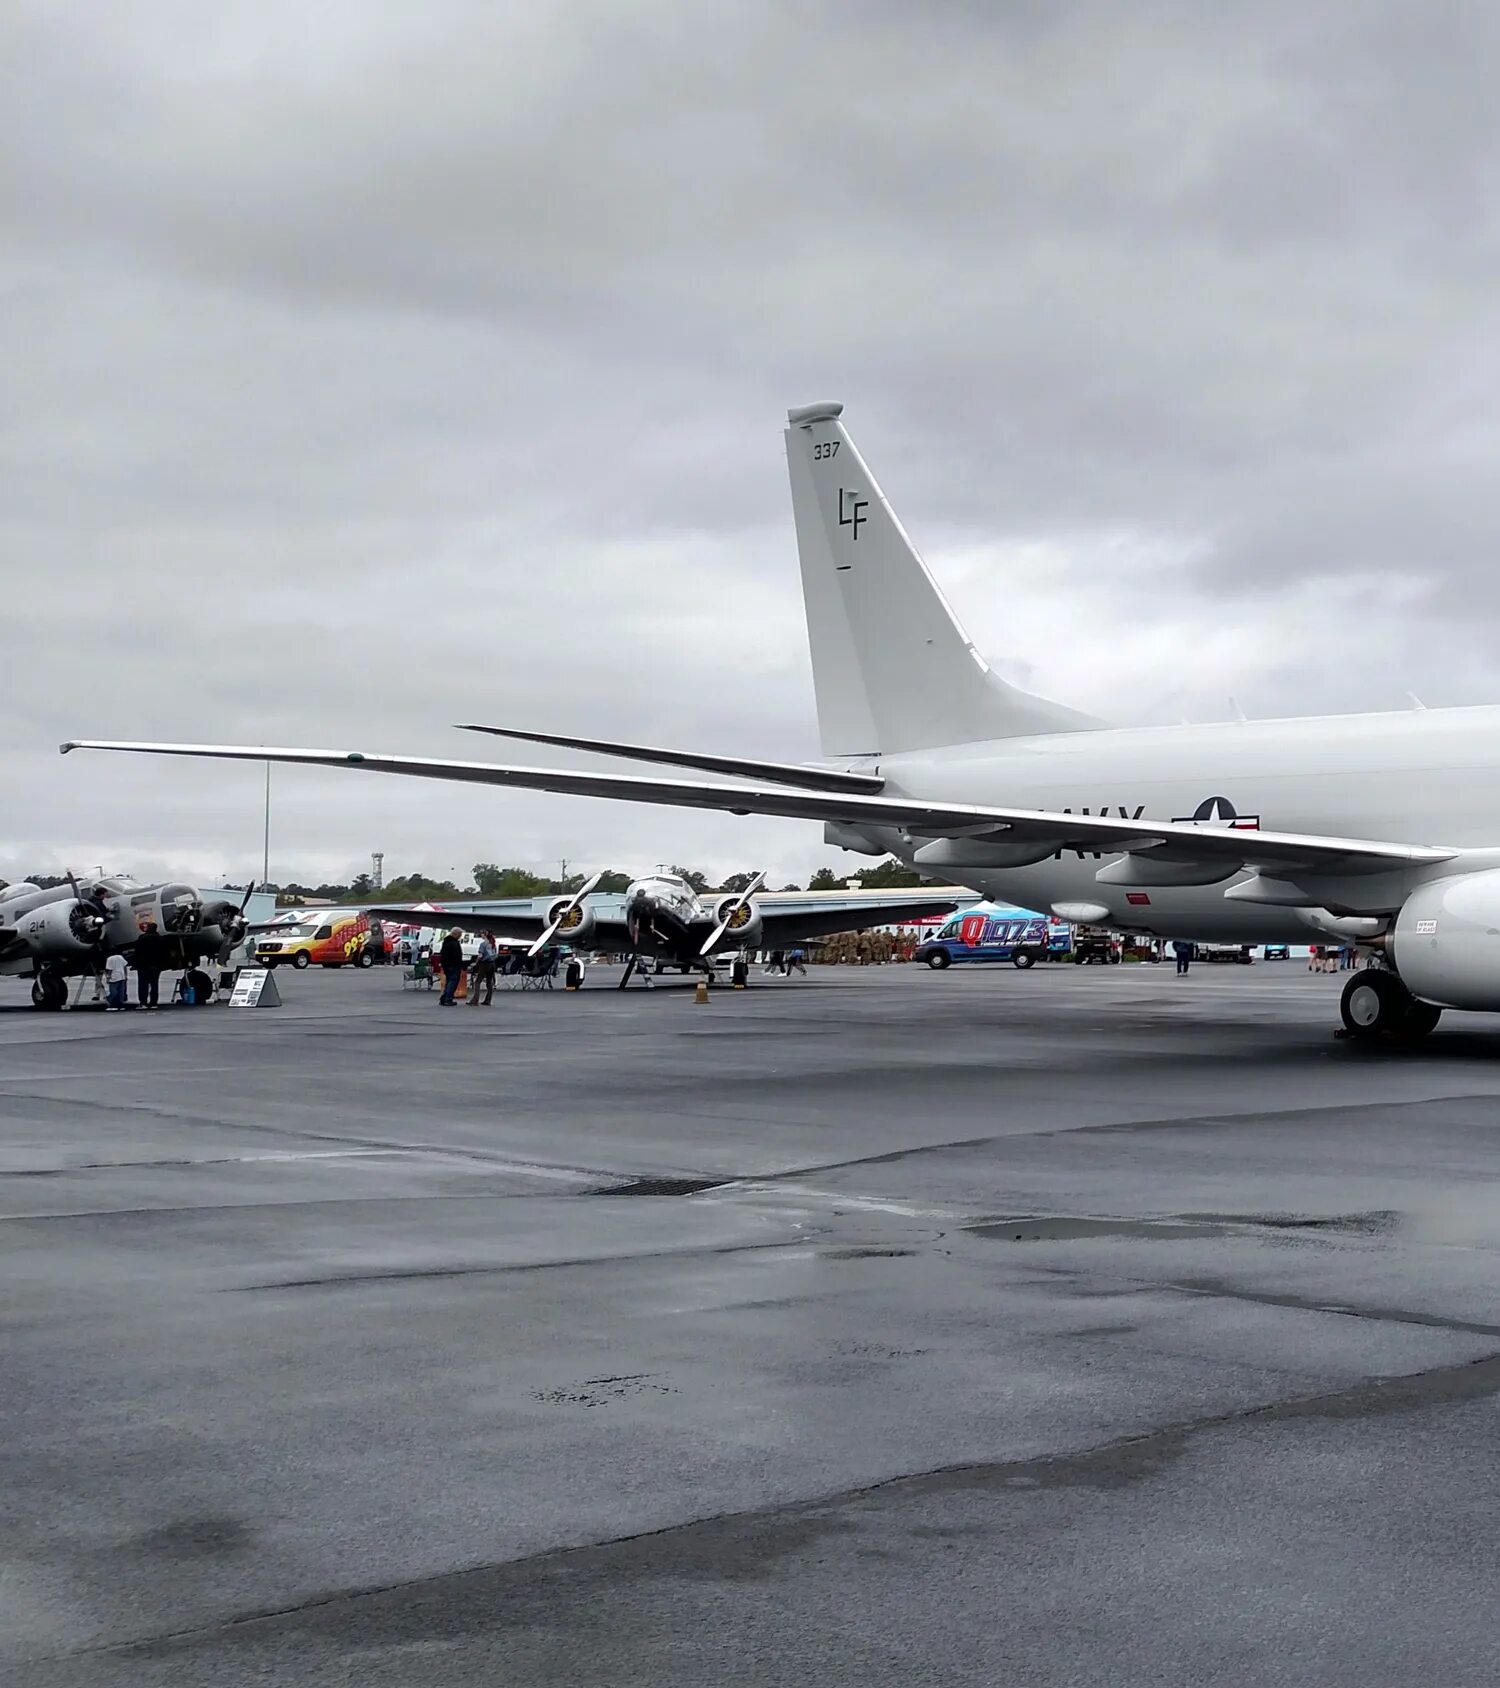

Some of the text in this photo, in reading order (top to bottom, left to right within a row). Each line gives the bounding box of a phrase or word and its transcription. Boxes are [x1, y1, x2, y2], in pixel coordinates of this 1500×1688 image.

[814, 441, 841, 460] 337
[838, 487, 869, 541] LF
[31, 919, 45, 932] 214
